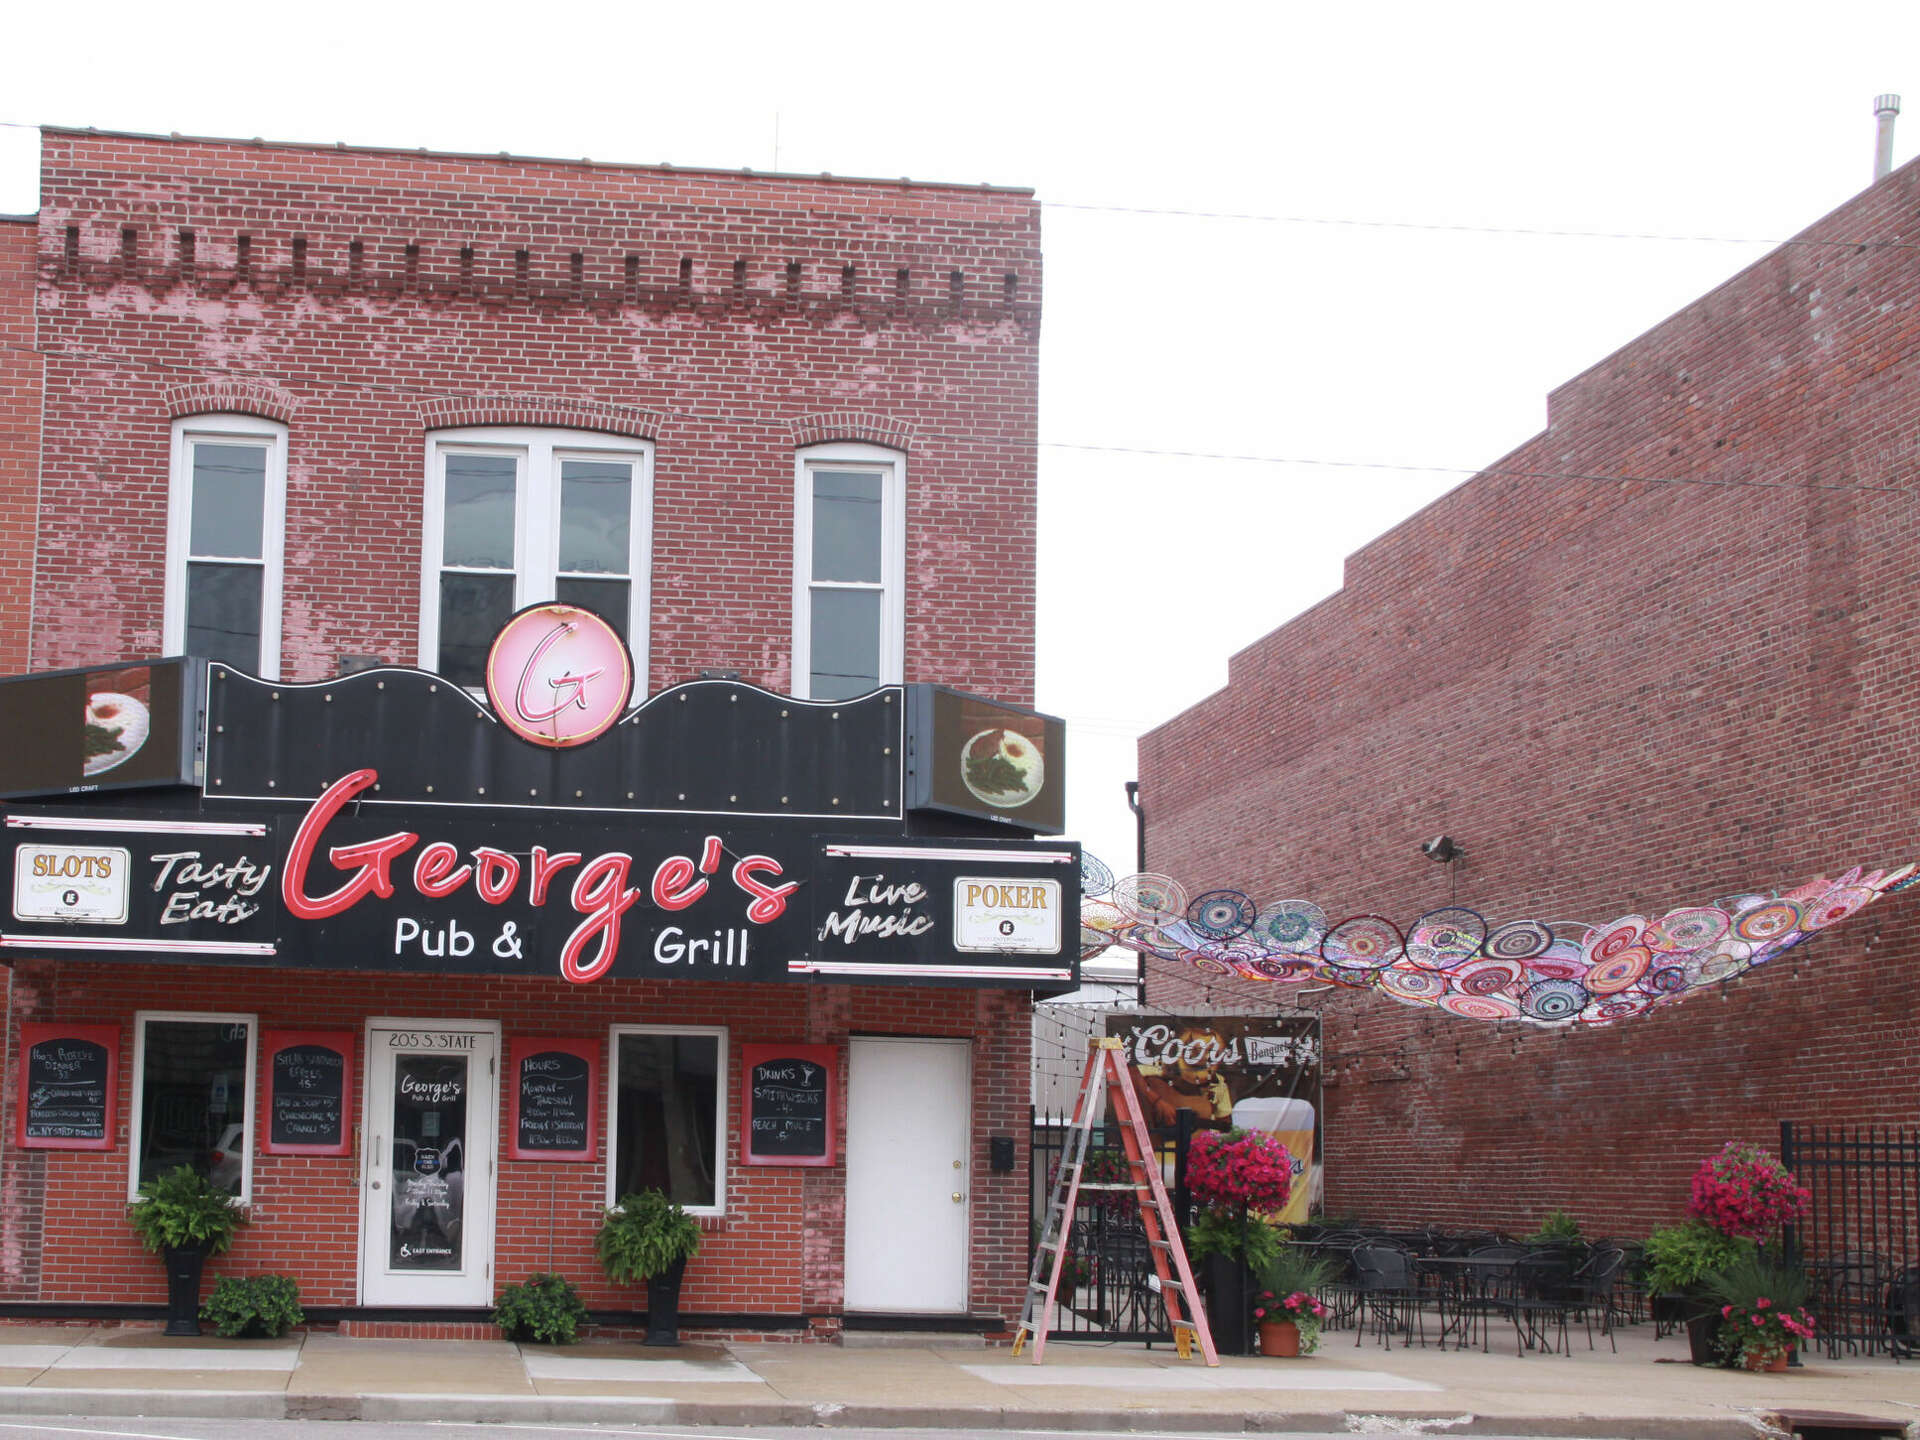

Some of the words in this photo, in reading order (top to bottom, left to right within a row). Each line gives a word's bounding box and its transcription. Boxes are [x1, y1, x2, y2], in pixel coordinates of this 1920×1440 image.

[516, 622, 606, 723] G
[33, 854, 112, 879] SLOTS
[150, 851, 271, 896] Tasty
[281, 768, 799, 984] George's
[844, 873, 927, 906] Live
[966, 884, 1048, 910] POKER
[160, 891, 260, 925] Eats
[817, 907, 935, 944] Music
[395, 917, 475, 957] Pub
[492, 920, 523, 959] &
[653, 927, 748, 966] Grill
[388, 1032, 419, 1048] 205
[422, 1033, 436, 1048] S.
[440, 1033, 477, 1049] STATE
[1132, 1024, 1243, 1066] Coors
[1250, 1038, 1291, 1062] Banquet
[524, 1059, 561, 1072] HOURS
[756, 1066, 797, 1081] DRINKS
[401, 1074, 461, 1103] George's
[412, 1094, 425, 1102] Pub
[752, 1119, 777, 1131] PEACH
[785, 1120, 811, 1132] MULE
